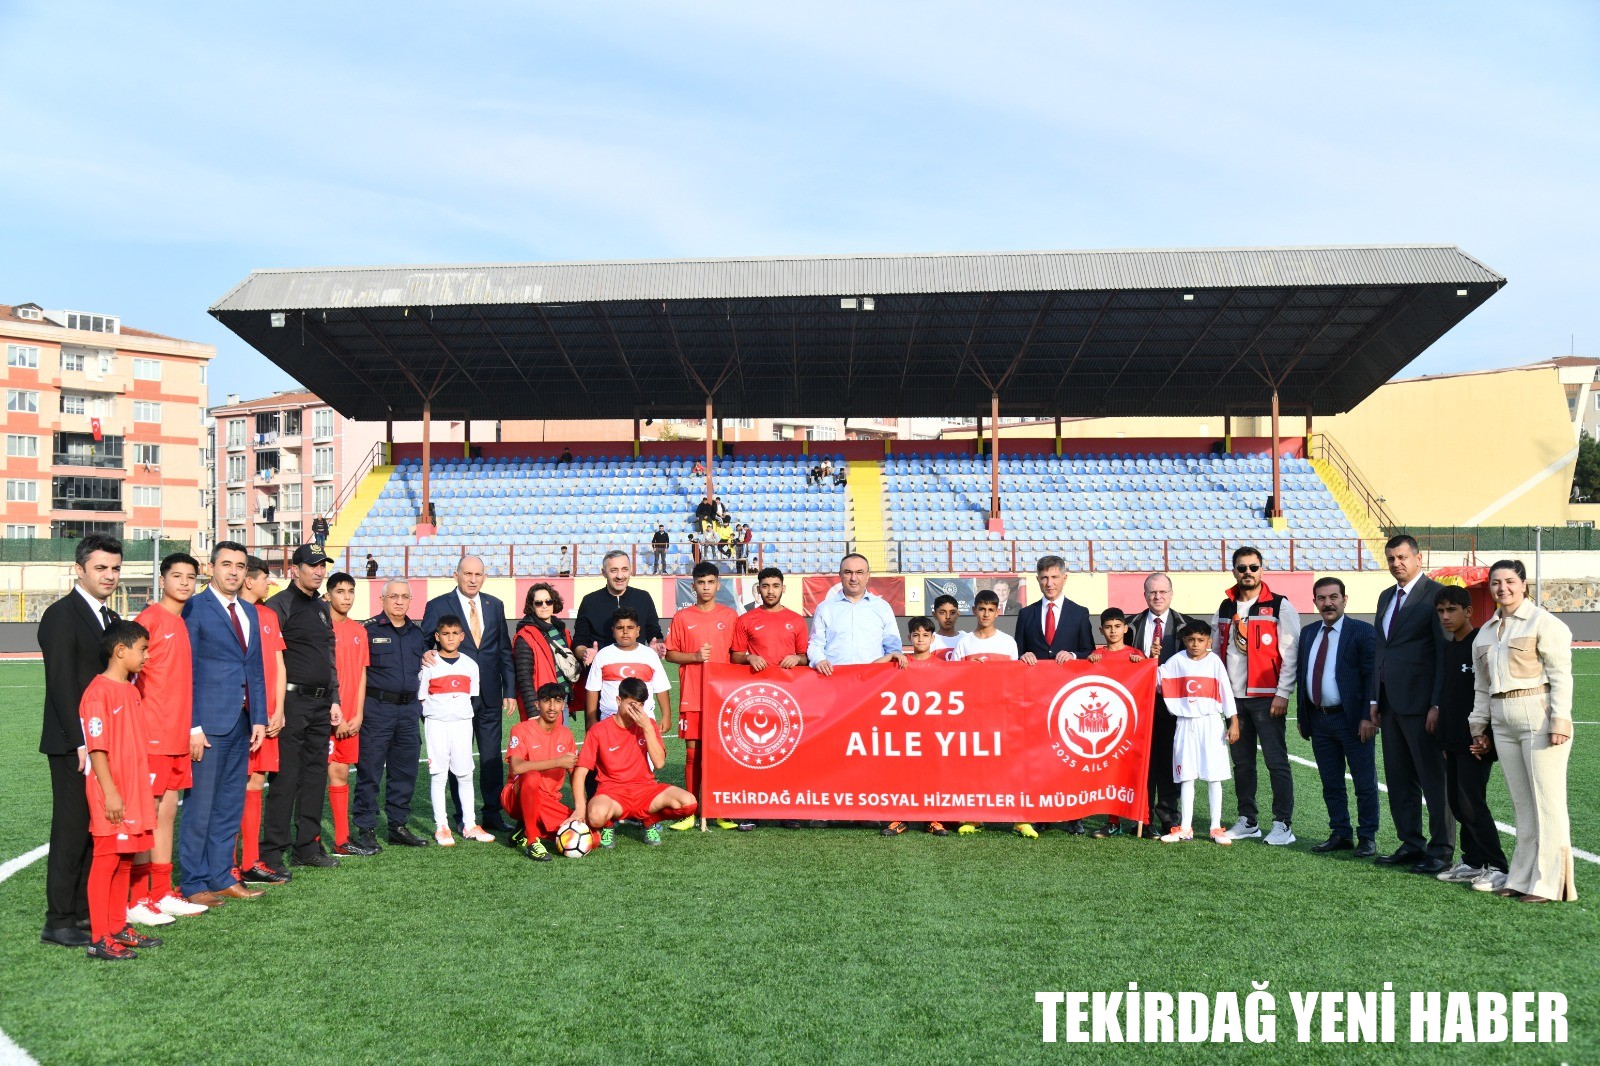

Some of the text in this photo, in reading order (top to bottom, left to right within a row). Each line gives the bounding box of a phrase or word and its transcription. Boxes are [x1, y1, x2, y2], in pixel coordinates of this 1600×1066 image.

[744, 699, 755, 707] AİLE
[880, 690, 965, 716] 2025
[846, 726, 1002, 757] AİLE YILI
[1051, 739, 1133, 773] 2025 AİLE YILI
[712, 785, 1135, 808] TEKİRDAĞ AİLE VE SOSYAL HİZMETLER İL MÜDÜRLÜĞÜ
